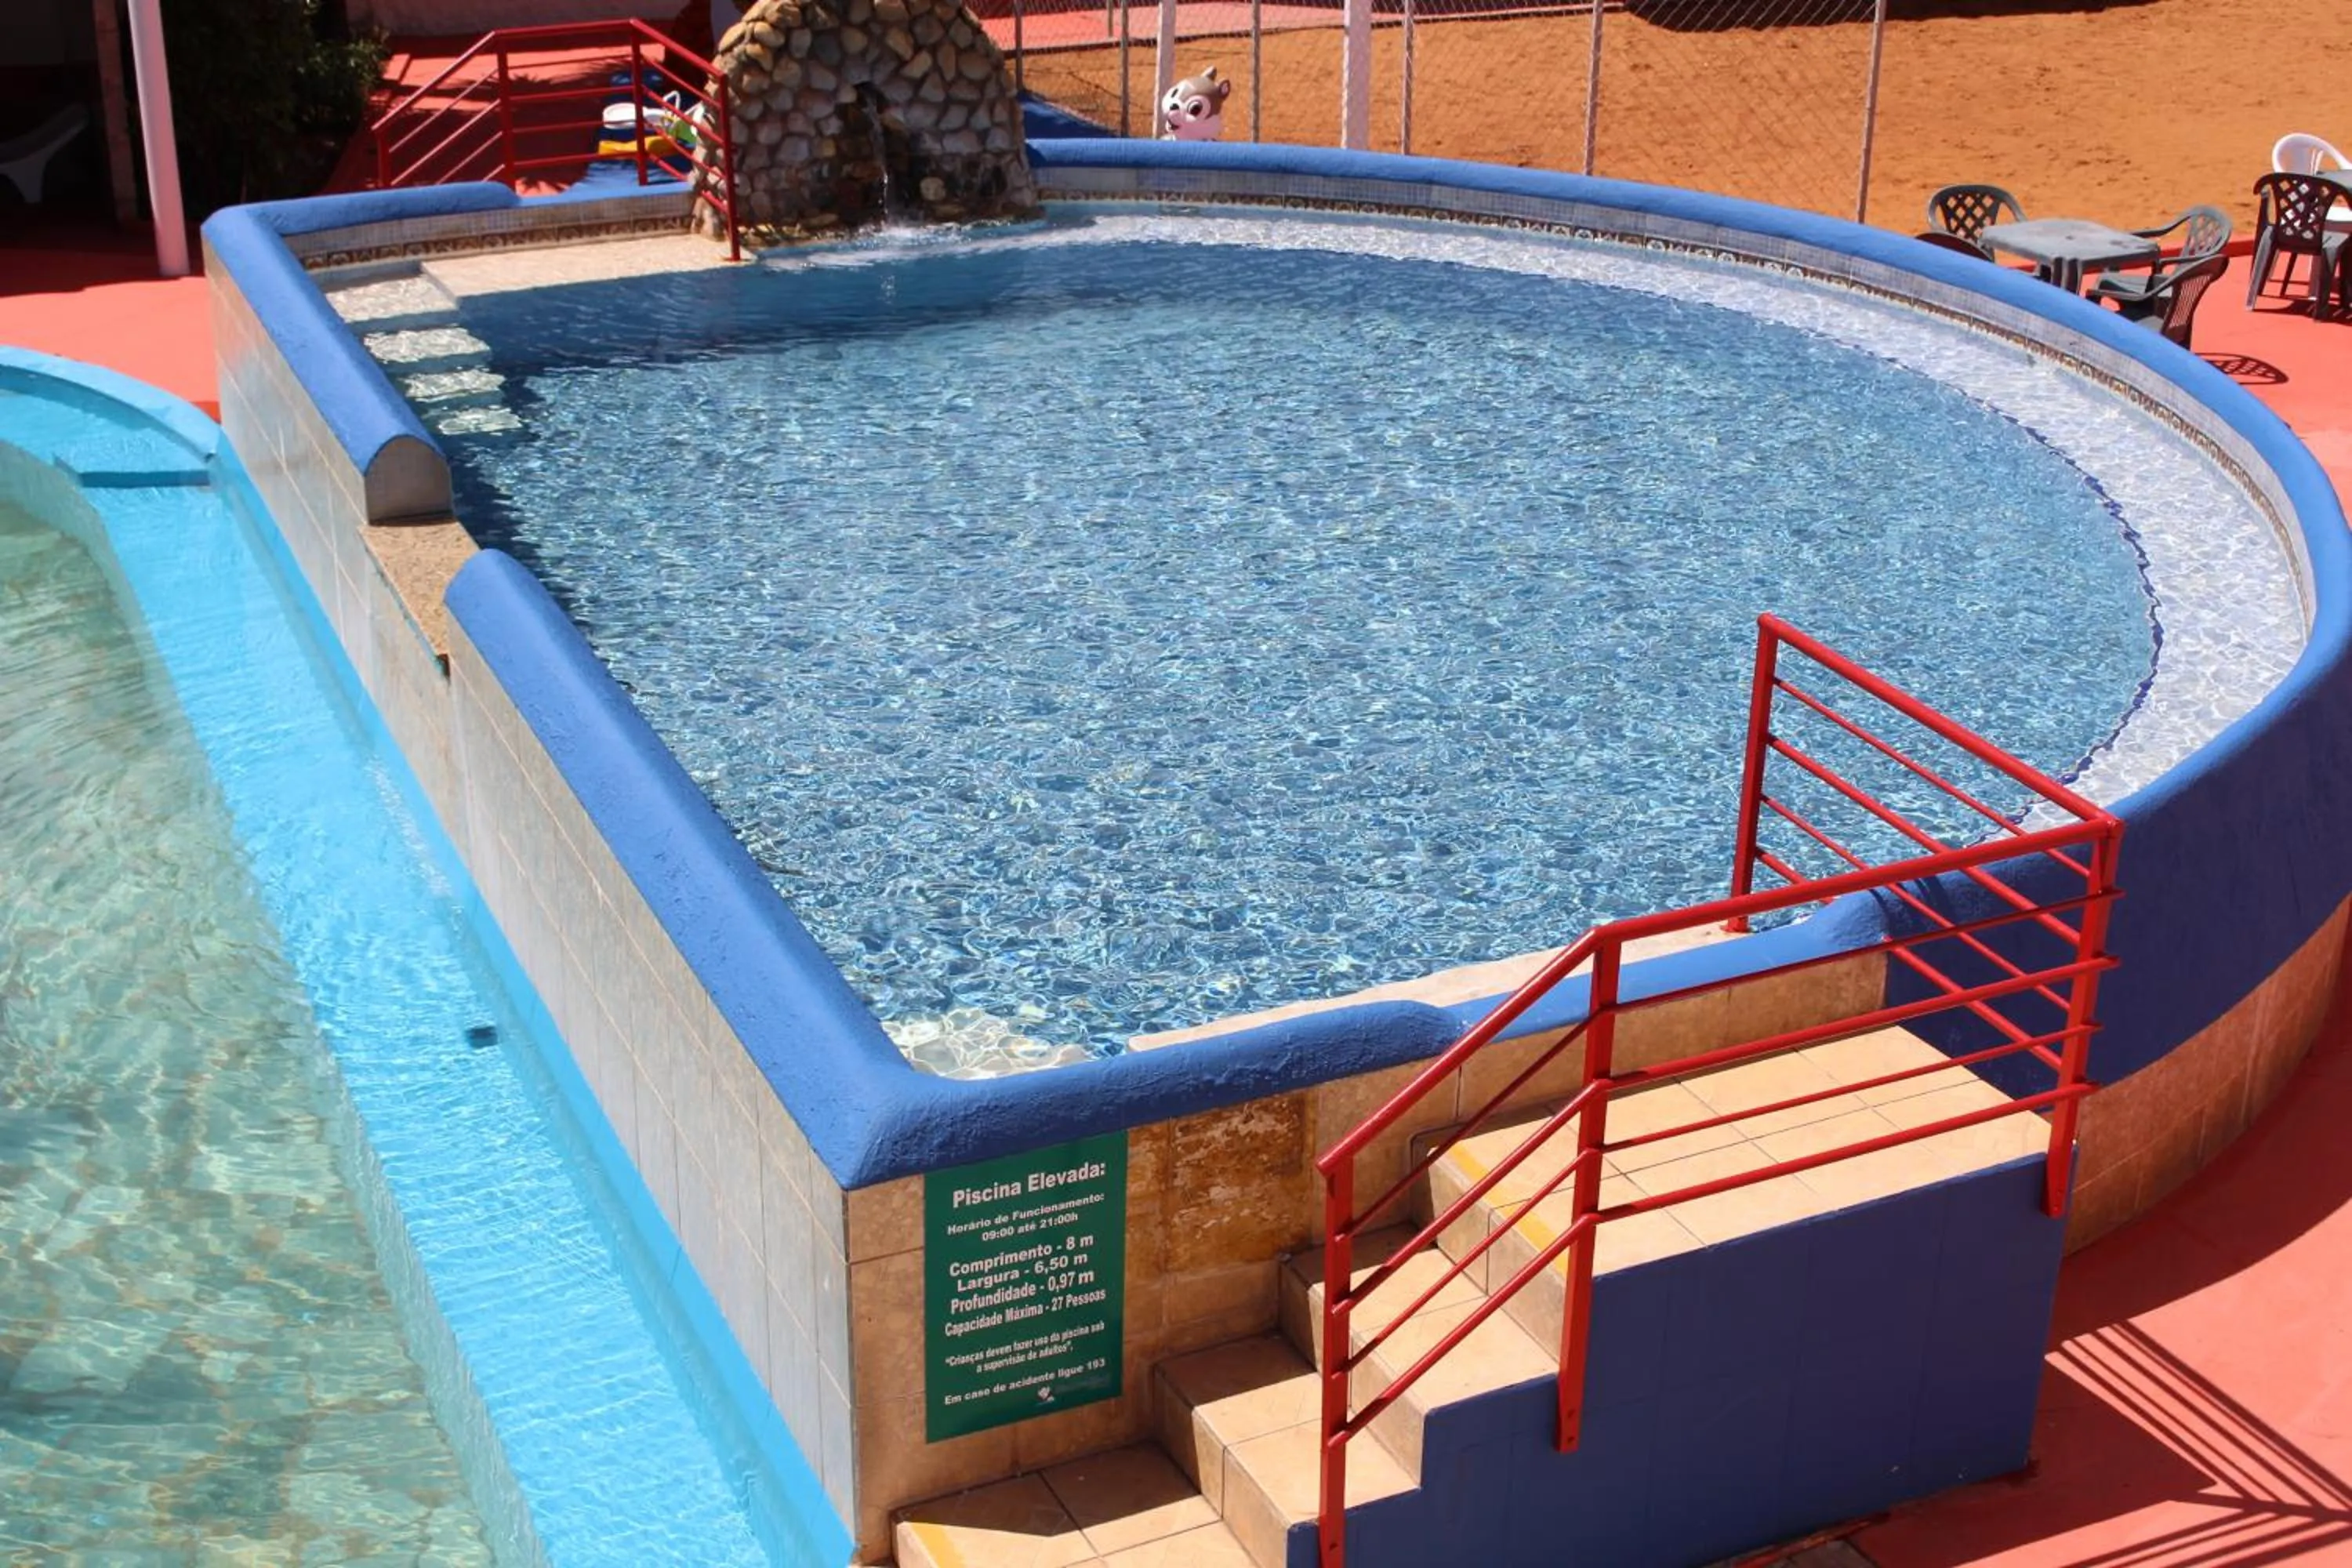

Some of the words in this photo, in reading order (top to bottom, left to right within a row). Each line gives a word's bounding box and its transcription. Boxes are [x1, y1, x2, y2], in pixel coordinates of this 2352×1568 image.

[953, 1181, 1022, 1208] Piscina
[1028, 1162, 1106, 1192] Elevada:
[947, 1218, 992, 1236] Horário
[994, 1214, 1009, 1225] de
[1012, 1192, 1105, 1221] Funcionamento:
[982, 1225, 1014, 1241] 09:00
[1017, 1221, 1036, 1234] até
[1040, 1211, 1079, 1229] 21:00h
[949, 1243, 1053, 1277] Comprimento
[1065, 1236, 1076, 1250] 8
[1080, 1235, 1094, 1247] m
[957, 1269, 1020, 1292] Largura
[1034, 1254, 1069, 1274] 6,50
[1073, 1254, 1088, 1265] m
[951, 1282, 1036, 1315] Profundidade
[1047, 1271, 1076, 1293] 0,97
[1078, 1270, 1095, 1285] m
[945, 1311, 1004, 1338] Capacidade
[1005, 1303, 1044, 1323] Máxima
[1051, 1296, 1064, 1312] 27
[1065, 1289, 1106, 1308] Pessoas
[976, 1365, 982, 1374] a
[983, 1353, 1026, 1371] supervisão
[1027, 1349, 1037, 1361] de
[985, 1344, 1013, 1359] devem
[1013, 1339, 1033, 1352] fazer
[1034, 1335, 1049, 1346] uso
[1062, 1325, 1090, 1342] piscina
[945, 1395, 961, 1405] Em
[964, 1388, 990, 1401] caso
[993, 1383, 1006, 1394] de
[1009, 1372, 1055, 1390] acidente
[1058, 1364, 1083, 1378] ligue
